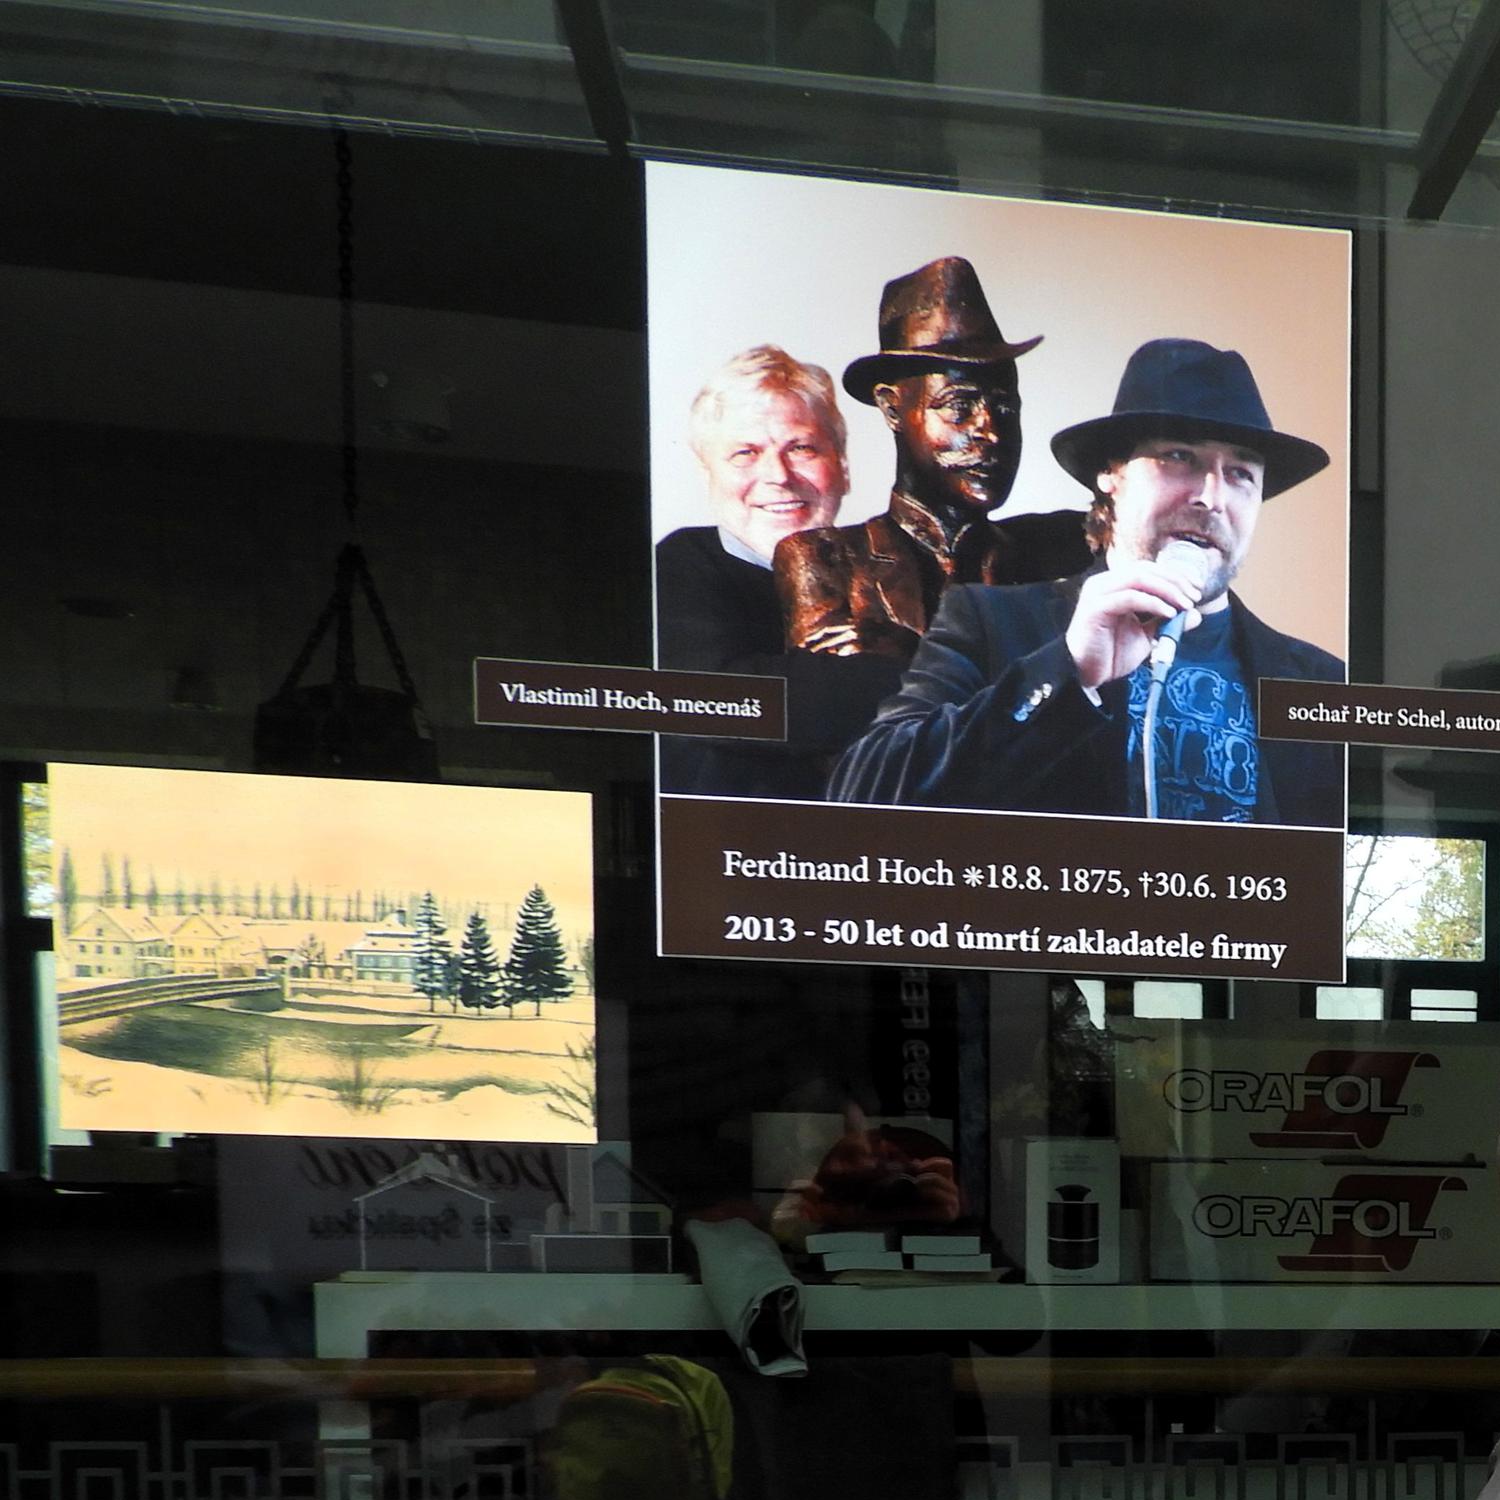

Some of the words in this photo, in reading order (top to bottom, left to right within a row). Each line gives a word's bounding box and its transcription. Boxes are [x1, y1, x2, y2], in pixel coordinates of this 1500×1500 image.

[499, 682, 599, 708] Vlastimil
[602, 689, 669, 714] Hoch,
[672, 697, 763, 718] mecenáš
[1288, 702, 1351, 723] sochař
[1354, 705, 1394, 726] Petr
[1397, 708, 1451, 731] Schel,
[723, 850, 871, 883] Ferdinand
[877, 858, 956, 887] Hoch
[1059, 867, 1131, 898] 1875,
[1226, 875, 1287, 902] 1963
[724, 915, 797, 942] 2013
[822, 919, 860, 945] 50
[864, 919, 904, 947] let
[909, 922, 950, 949] od
[955, 923, 1042, 952] úmrtí
[1046, 928, 1205, 959] zakladatele
[1210, 933, 1288, 969] firmy
[1163, 1068, 1408, 1115] ORAFOL
[1192, 1194, 1436, 1239] ORAFOL
